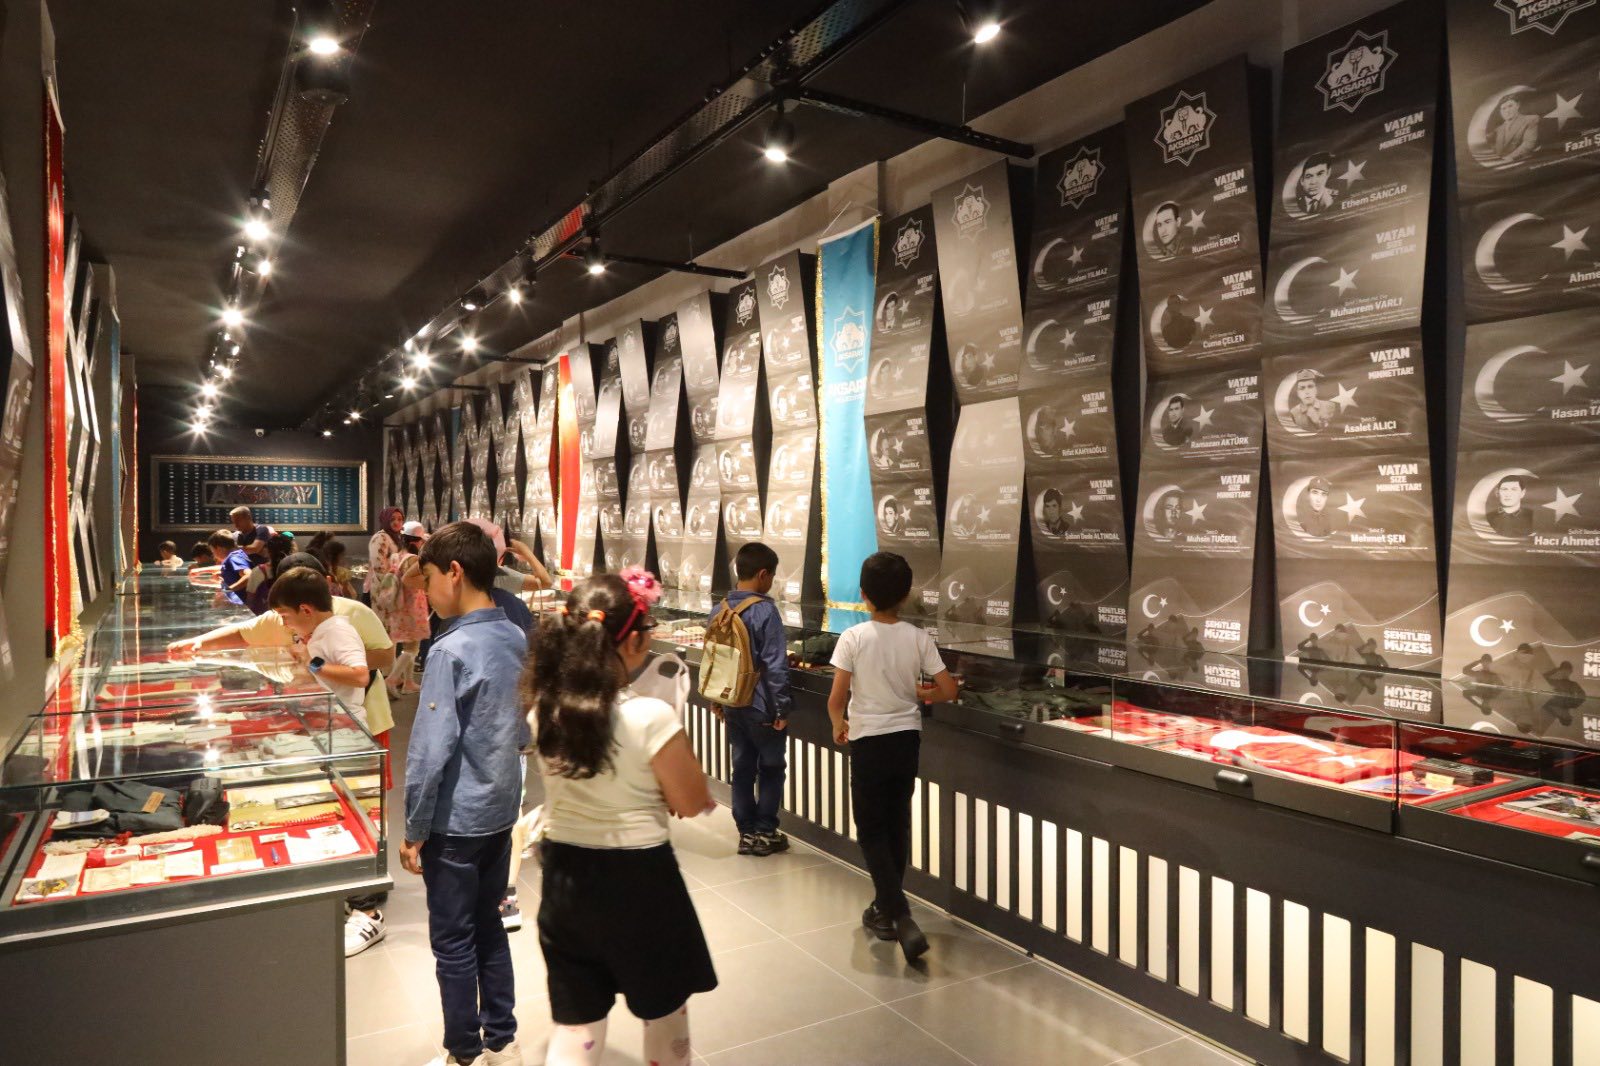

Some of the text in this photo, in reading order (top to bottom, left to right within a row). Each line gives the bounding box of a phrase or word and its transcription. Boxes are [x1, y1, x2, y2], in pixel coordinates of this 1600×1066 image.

[1330, 74, 1379, 99] AKSARAY
[1384, 111, 1424, 133] VATAN
[1168, 132, 1204, 152] AKSARAY
[1565, 137, 1591, 152] Fazlı
[1214, 168, 1245, 187] VATAN
[1341, 197, 1369, 210] Ethem
[1369, 184, 1408, 202] SANCAR
[1376, 225, 1416, 244] VATAN
[1223, 270, 1253, 286] VATAN
[1087, 299, 1110, 312] VATAN
[1330, 303, 1373, 318] Muharrem
[1375, 297, 1403, 309] VARLI
[1222, 334, 1245, 347] ÇELEN
[1370, 347, 1410, 363] VATAN
[1228, 376, 1258, 389] VATAN
[1082, 392, 1105, 402] VATAN
[1552, 409, 1587, 419] Hasan
[1344, 421, 1397, 433] Asalet ALICI
[1191, 440, 1220, 449] Ramazan
[1221, 436, 1249, 446] AKTÜRK
[1378, 464, 1419, 476] VATAN
[1090, 480, 1113, 488] VATAN
[1220, 474, 1250, 485] VATAN
[1187, 535, 1211, 543] Muhsin
[1350, 534, 1406, 545] Mehmet ŞEN
[1534, 536, 1600, 546] Hacı Ahmet
